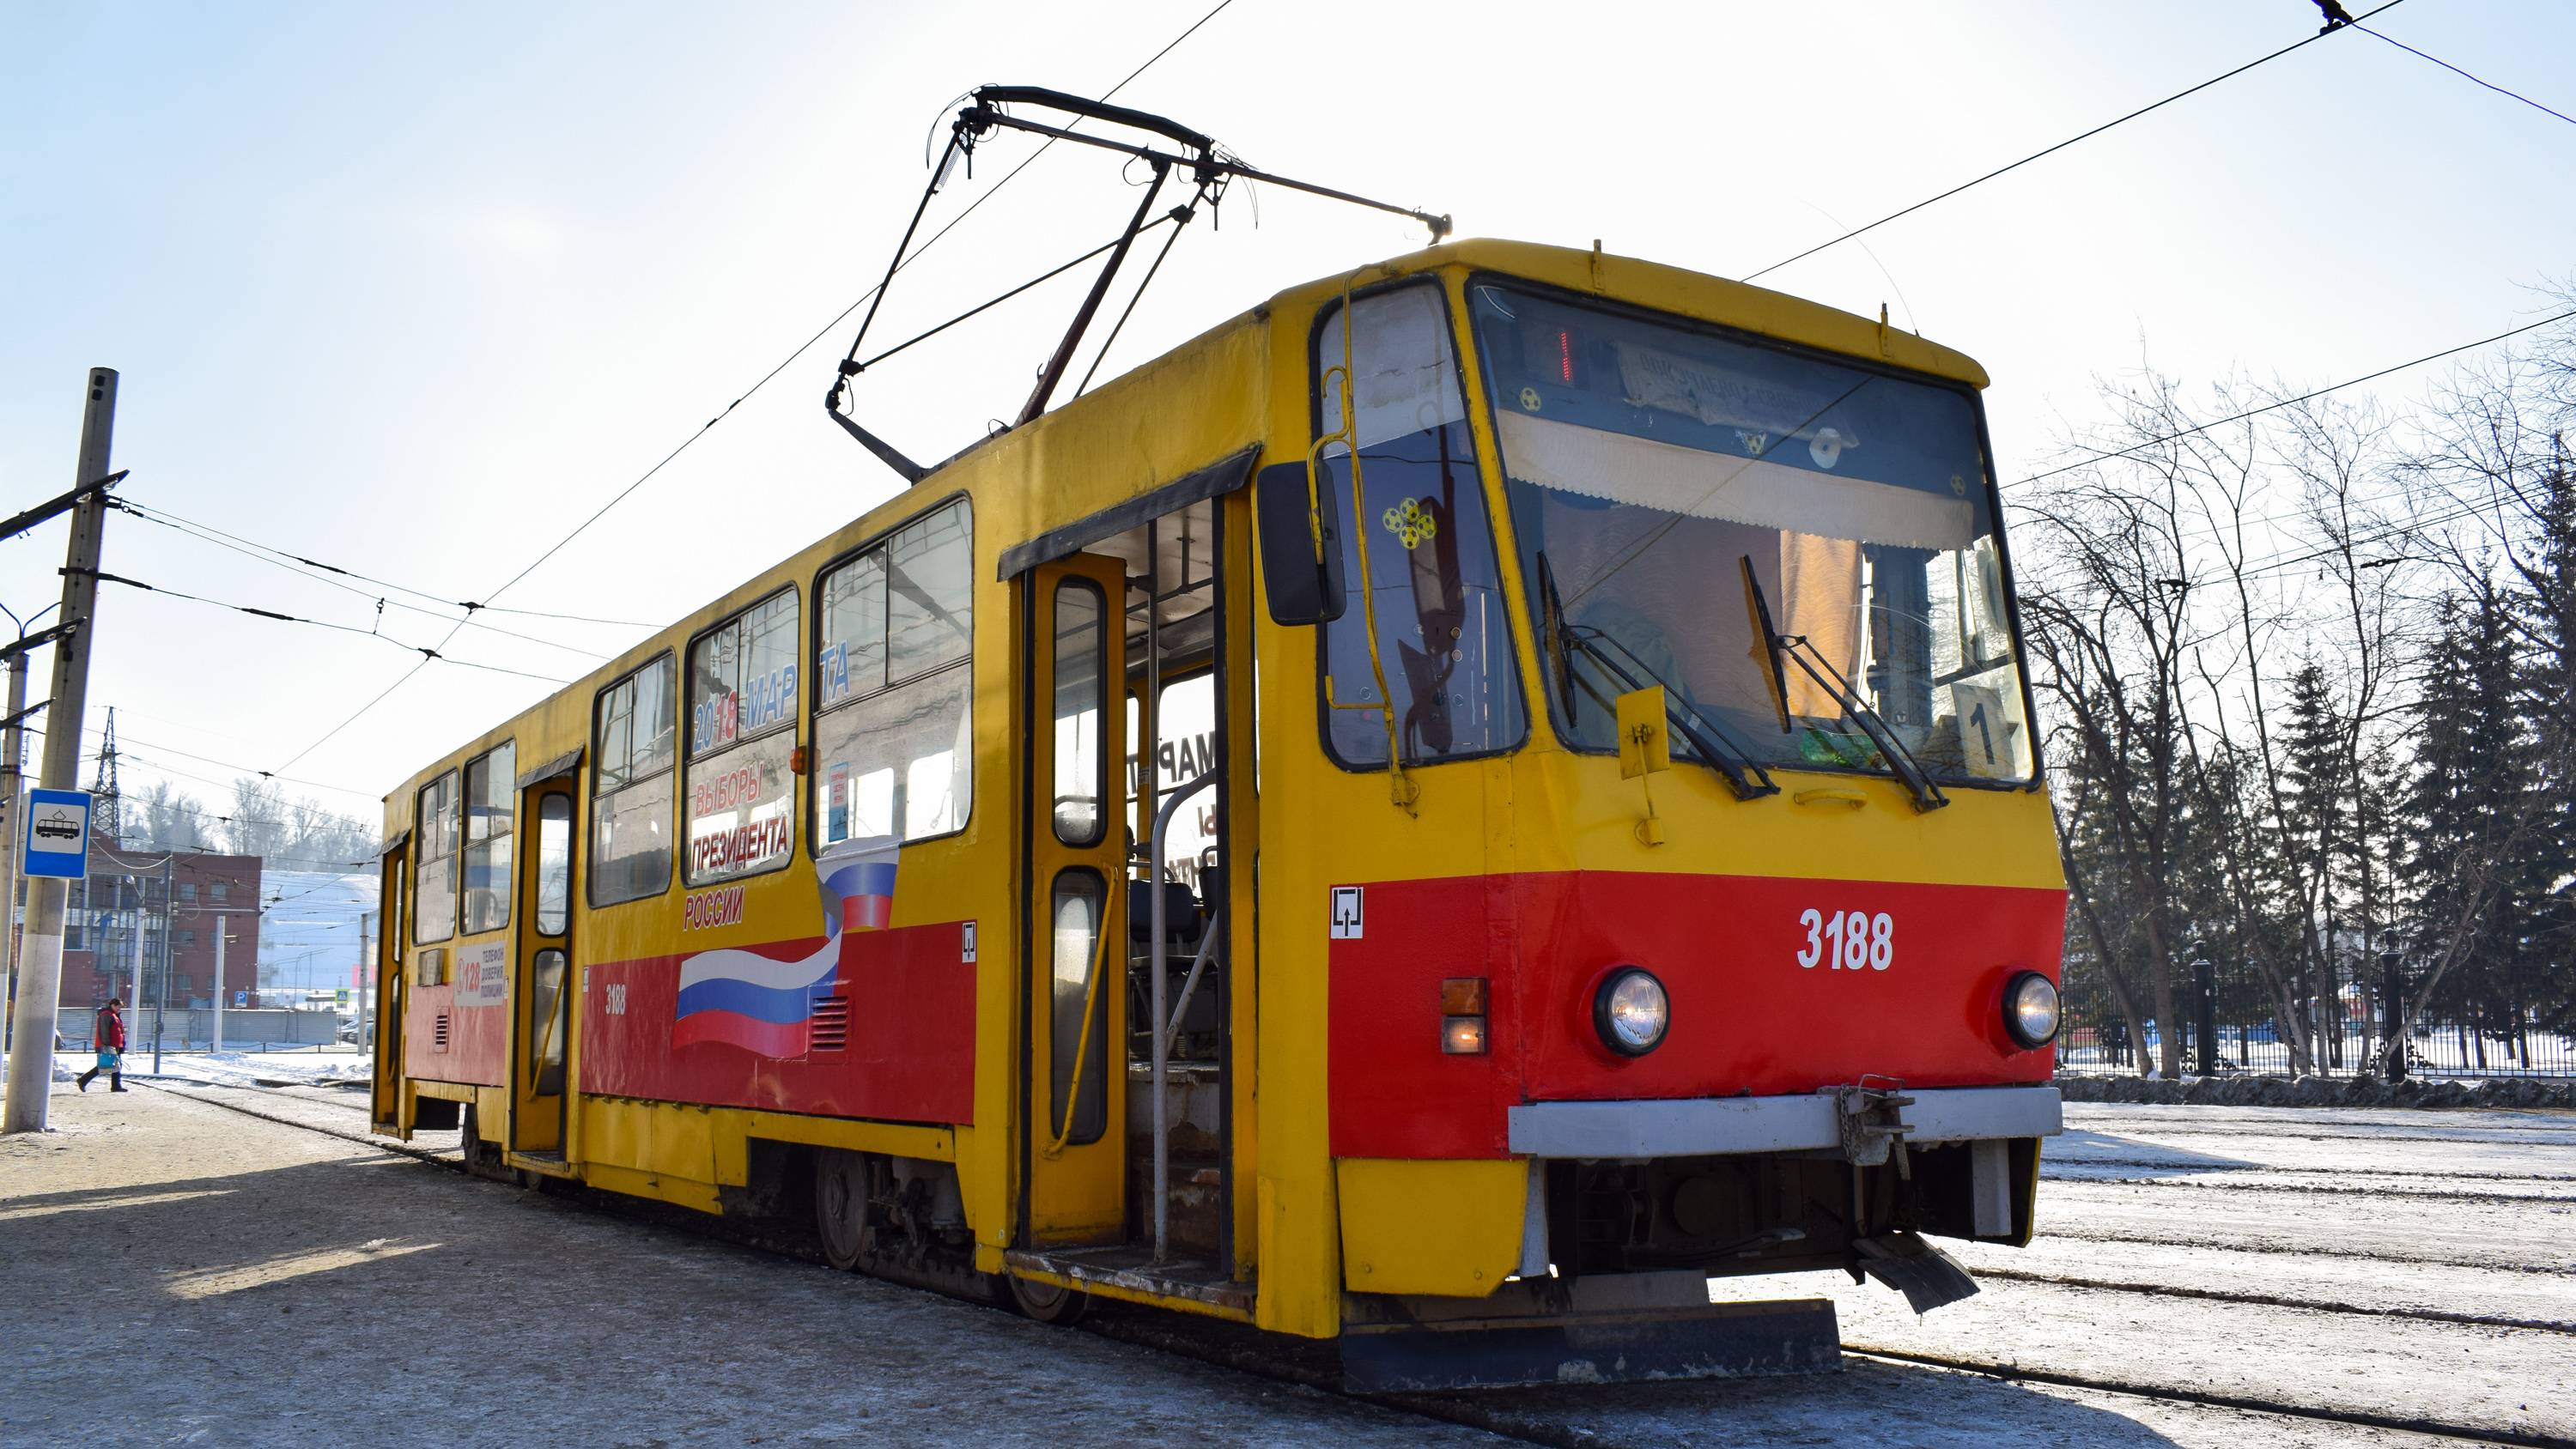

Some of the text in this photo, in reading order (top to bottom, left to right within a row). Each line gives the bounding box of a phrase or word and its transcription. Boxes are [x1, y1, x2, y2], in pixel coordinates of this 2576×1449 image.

[693, 689, 738, 754] 2018
[1970, 702, 1995, 764] 1
[695, 761, 764, 817] ВЫБОРЫ
[691, 814, 788, 874] ПРЕЗИДЕНТА
[683, 885, 745, 931] РОССИИ
[483, 948, 504, 962] ТЕЛЕФОН
[1796, 908, 1893, 971] 3188
[465, 961, 480, 991] 128
[481, 965, 503, 981] ДОВЕРИЯ
[481, 984, 503, 998] ПОЛИЦИИ
[605, 984, 626, 1016] 3188
